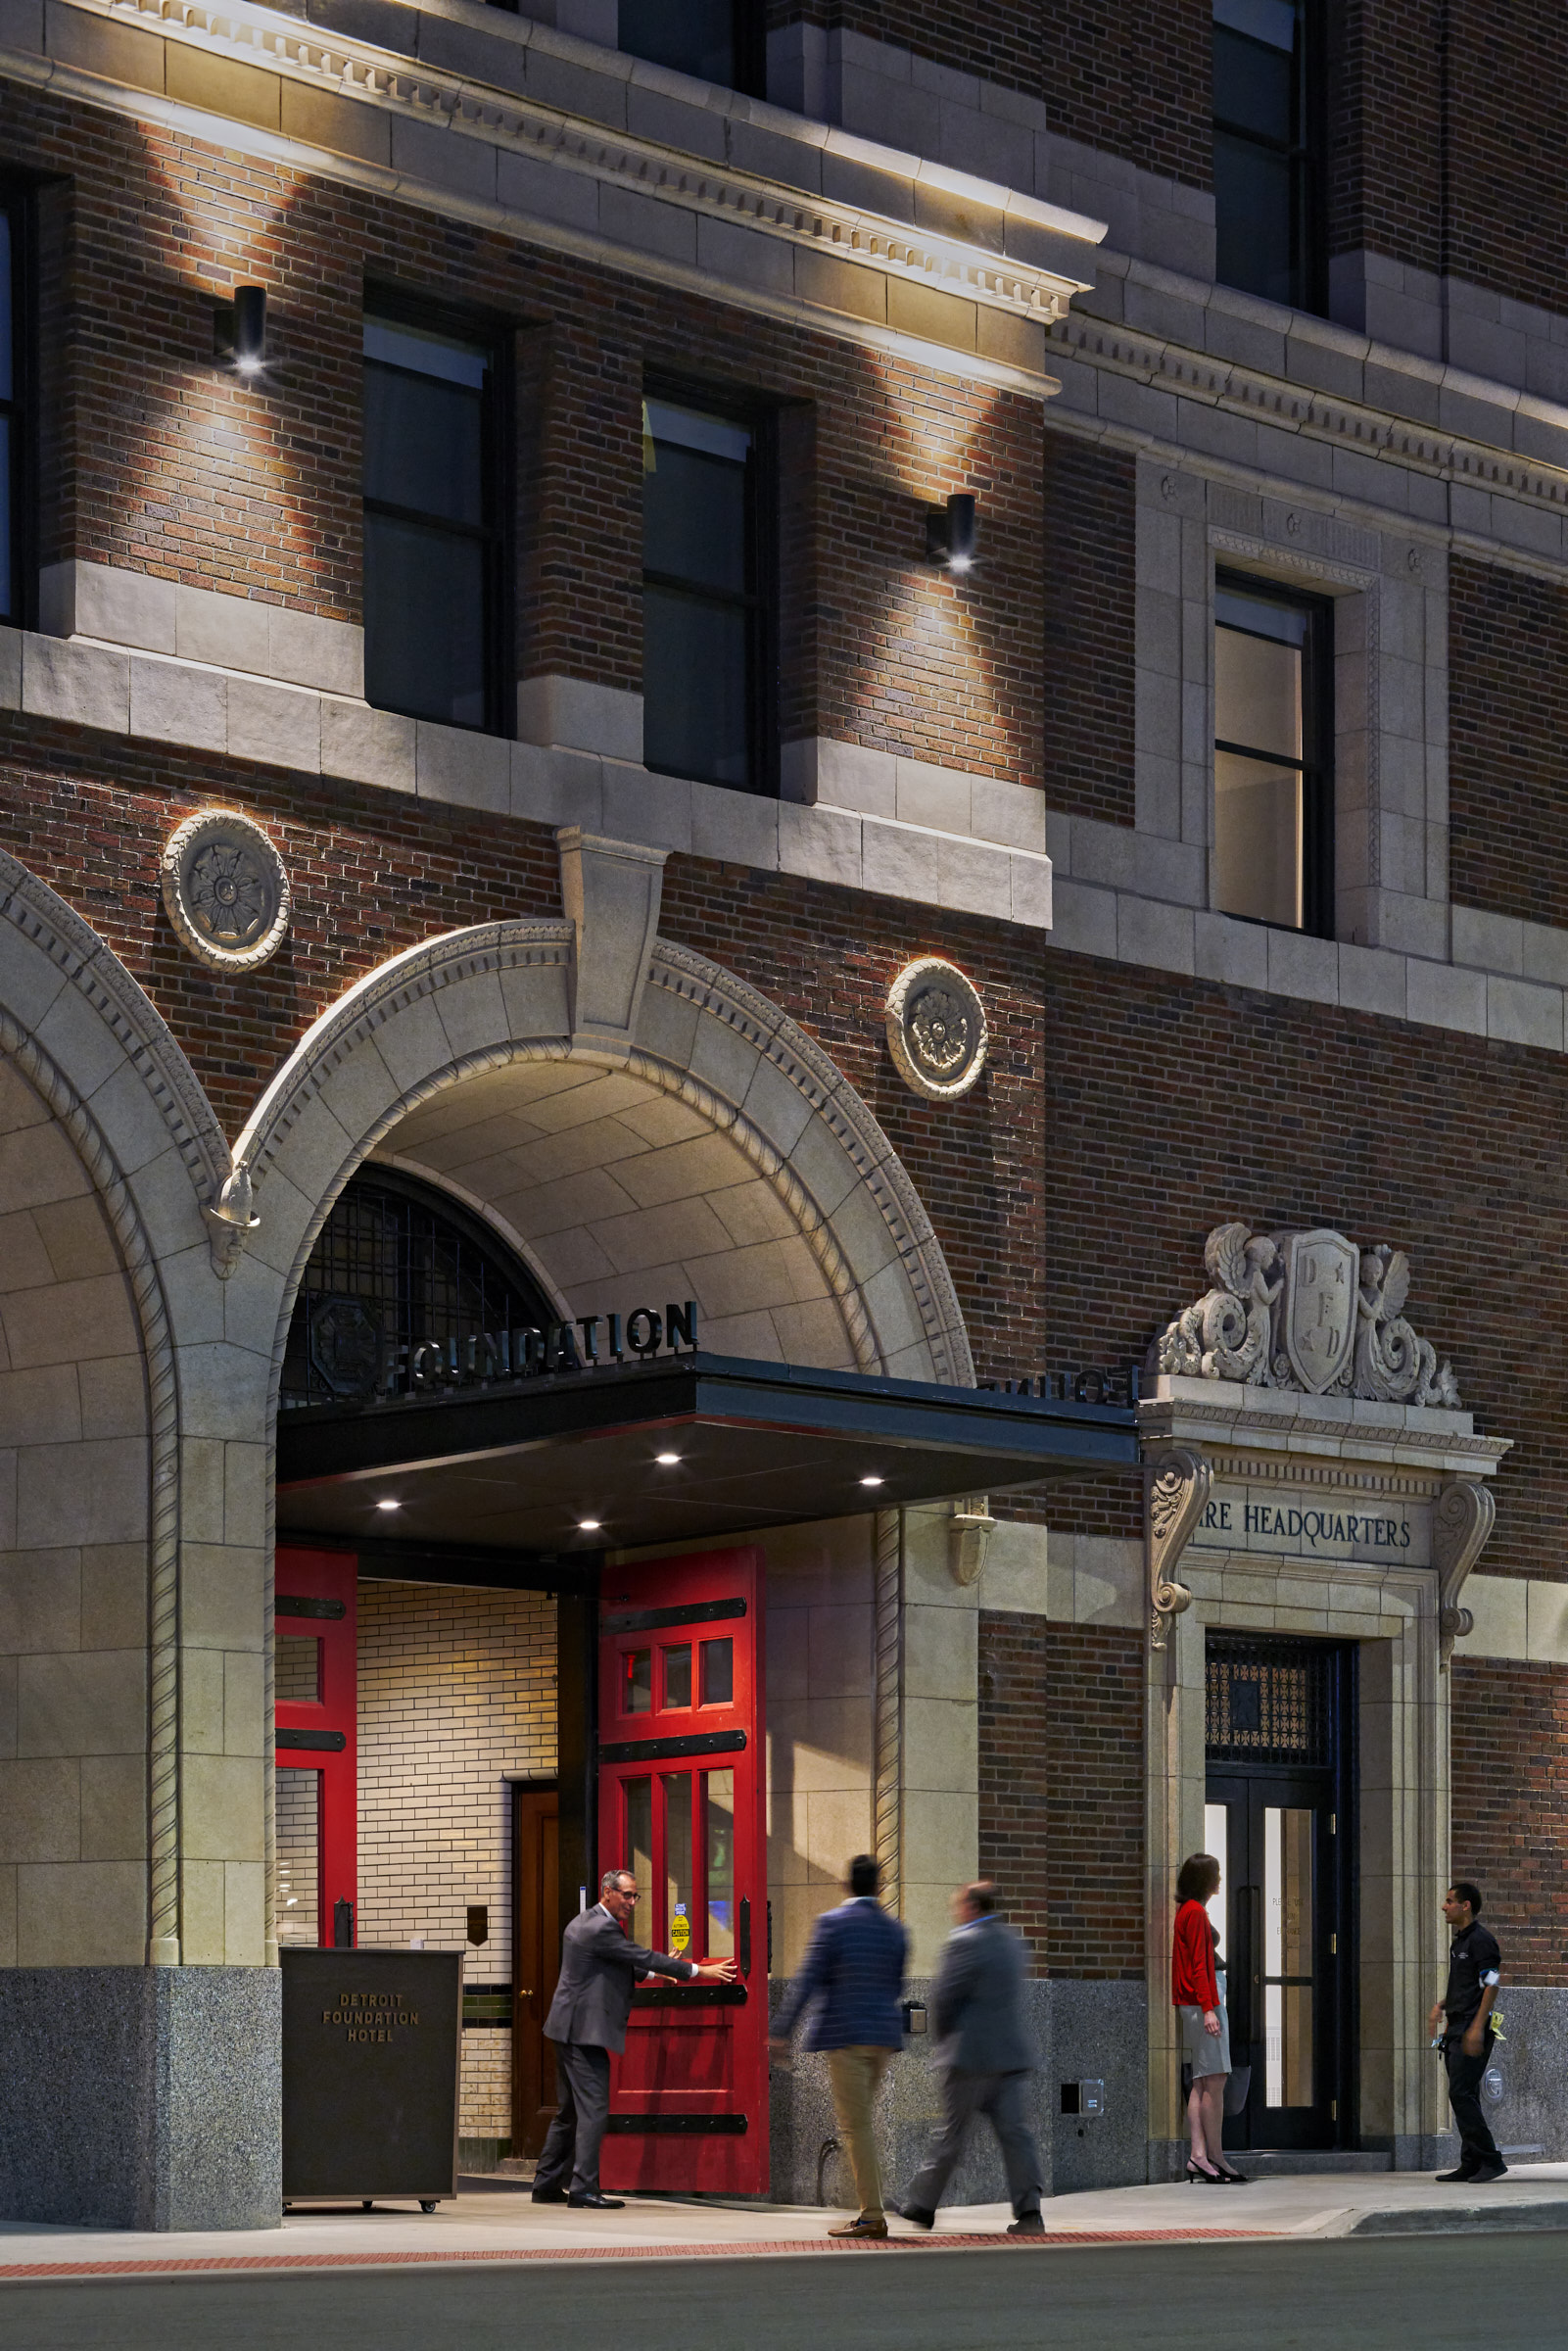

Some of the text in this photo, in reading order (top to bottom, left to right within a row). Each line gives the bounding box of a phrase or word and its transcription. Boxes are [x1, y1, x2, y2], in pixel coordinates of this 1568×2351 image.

[383, 1300, 698, 1390] FOUNDATION
[1244, 1505, 1410, 1548] HEADQUARTERS
[340, 1993, 403, 2007] DETROIT
[322, 2011, 419, 2025] FOUNDATION
[347, 2029, 394, 2042] HOTEL
